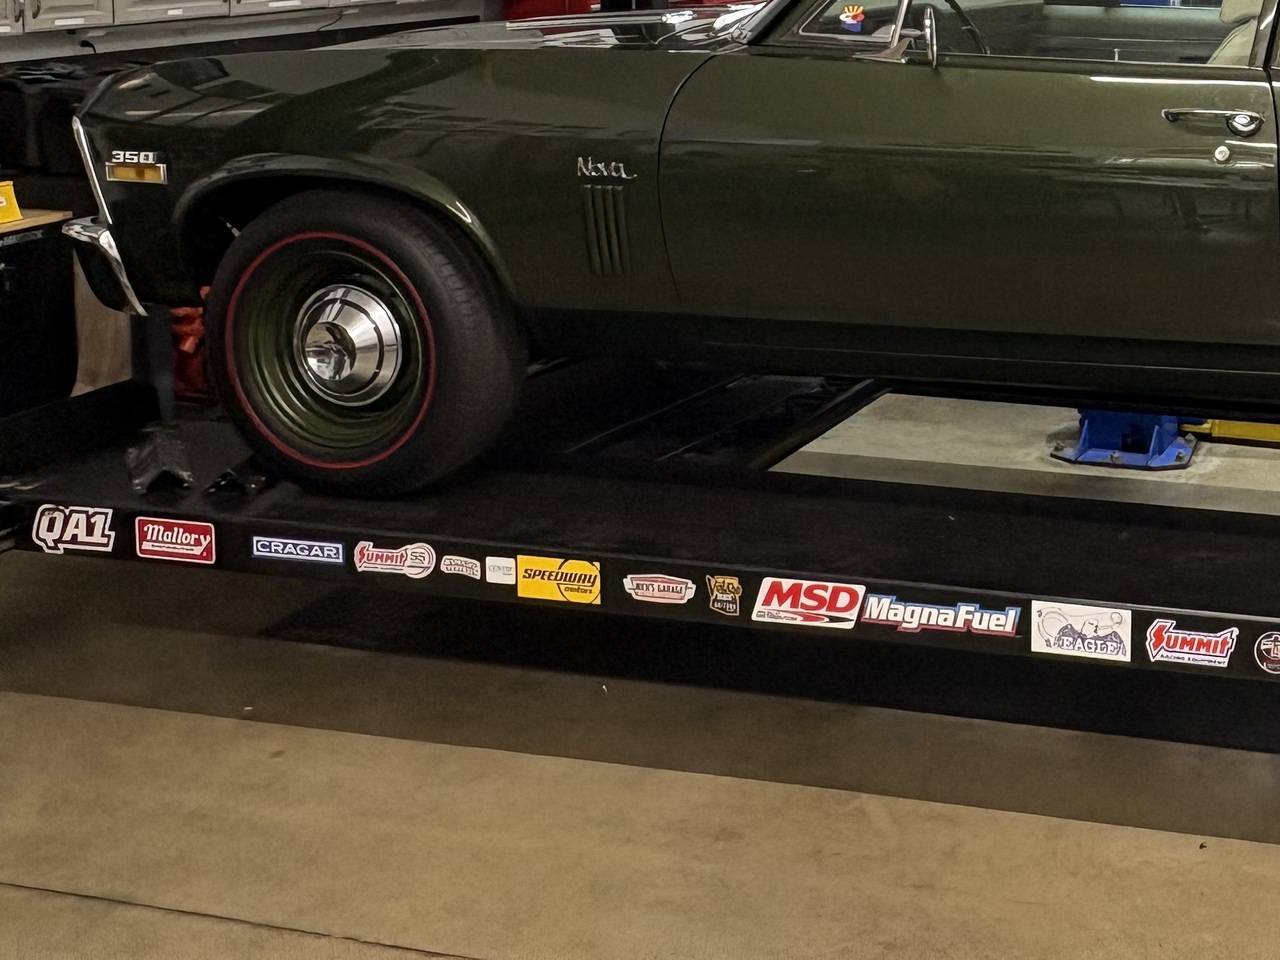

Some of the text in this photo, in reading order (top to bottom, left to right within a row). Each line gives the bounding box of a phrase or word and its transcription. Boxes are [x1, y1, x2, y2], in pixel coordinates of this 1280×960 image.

[111, 150, 154, 164] 350
[577, 156, 638, 179] Nova
[37, 510, 110, 549] QA1
[143, 524, 212, 548] Mallory
[256, 540, 339, 559] CRAGAR
[358, 546, 406, 567] SUMMIT
[522, 567, 598, 588] SPEEDWAY
[761, 580, 860, 613] MSD
[865, 596, 1017, 632] MagnaFuel
[1059, 636, 1119, 654] EAGLE
[1152, 624, 1232, 655] SUMMIT
